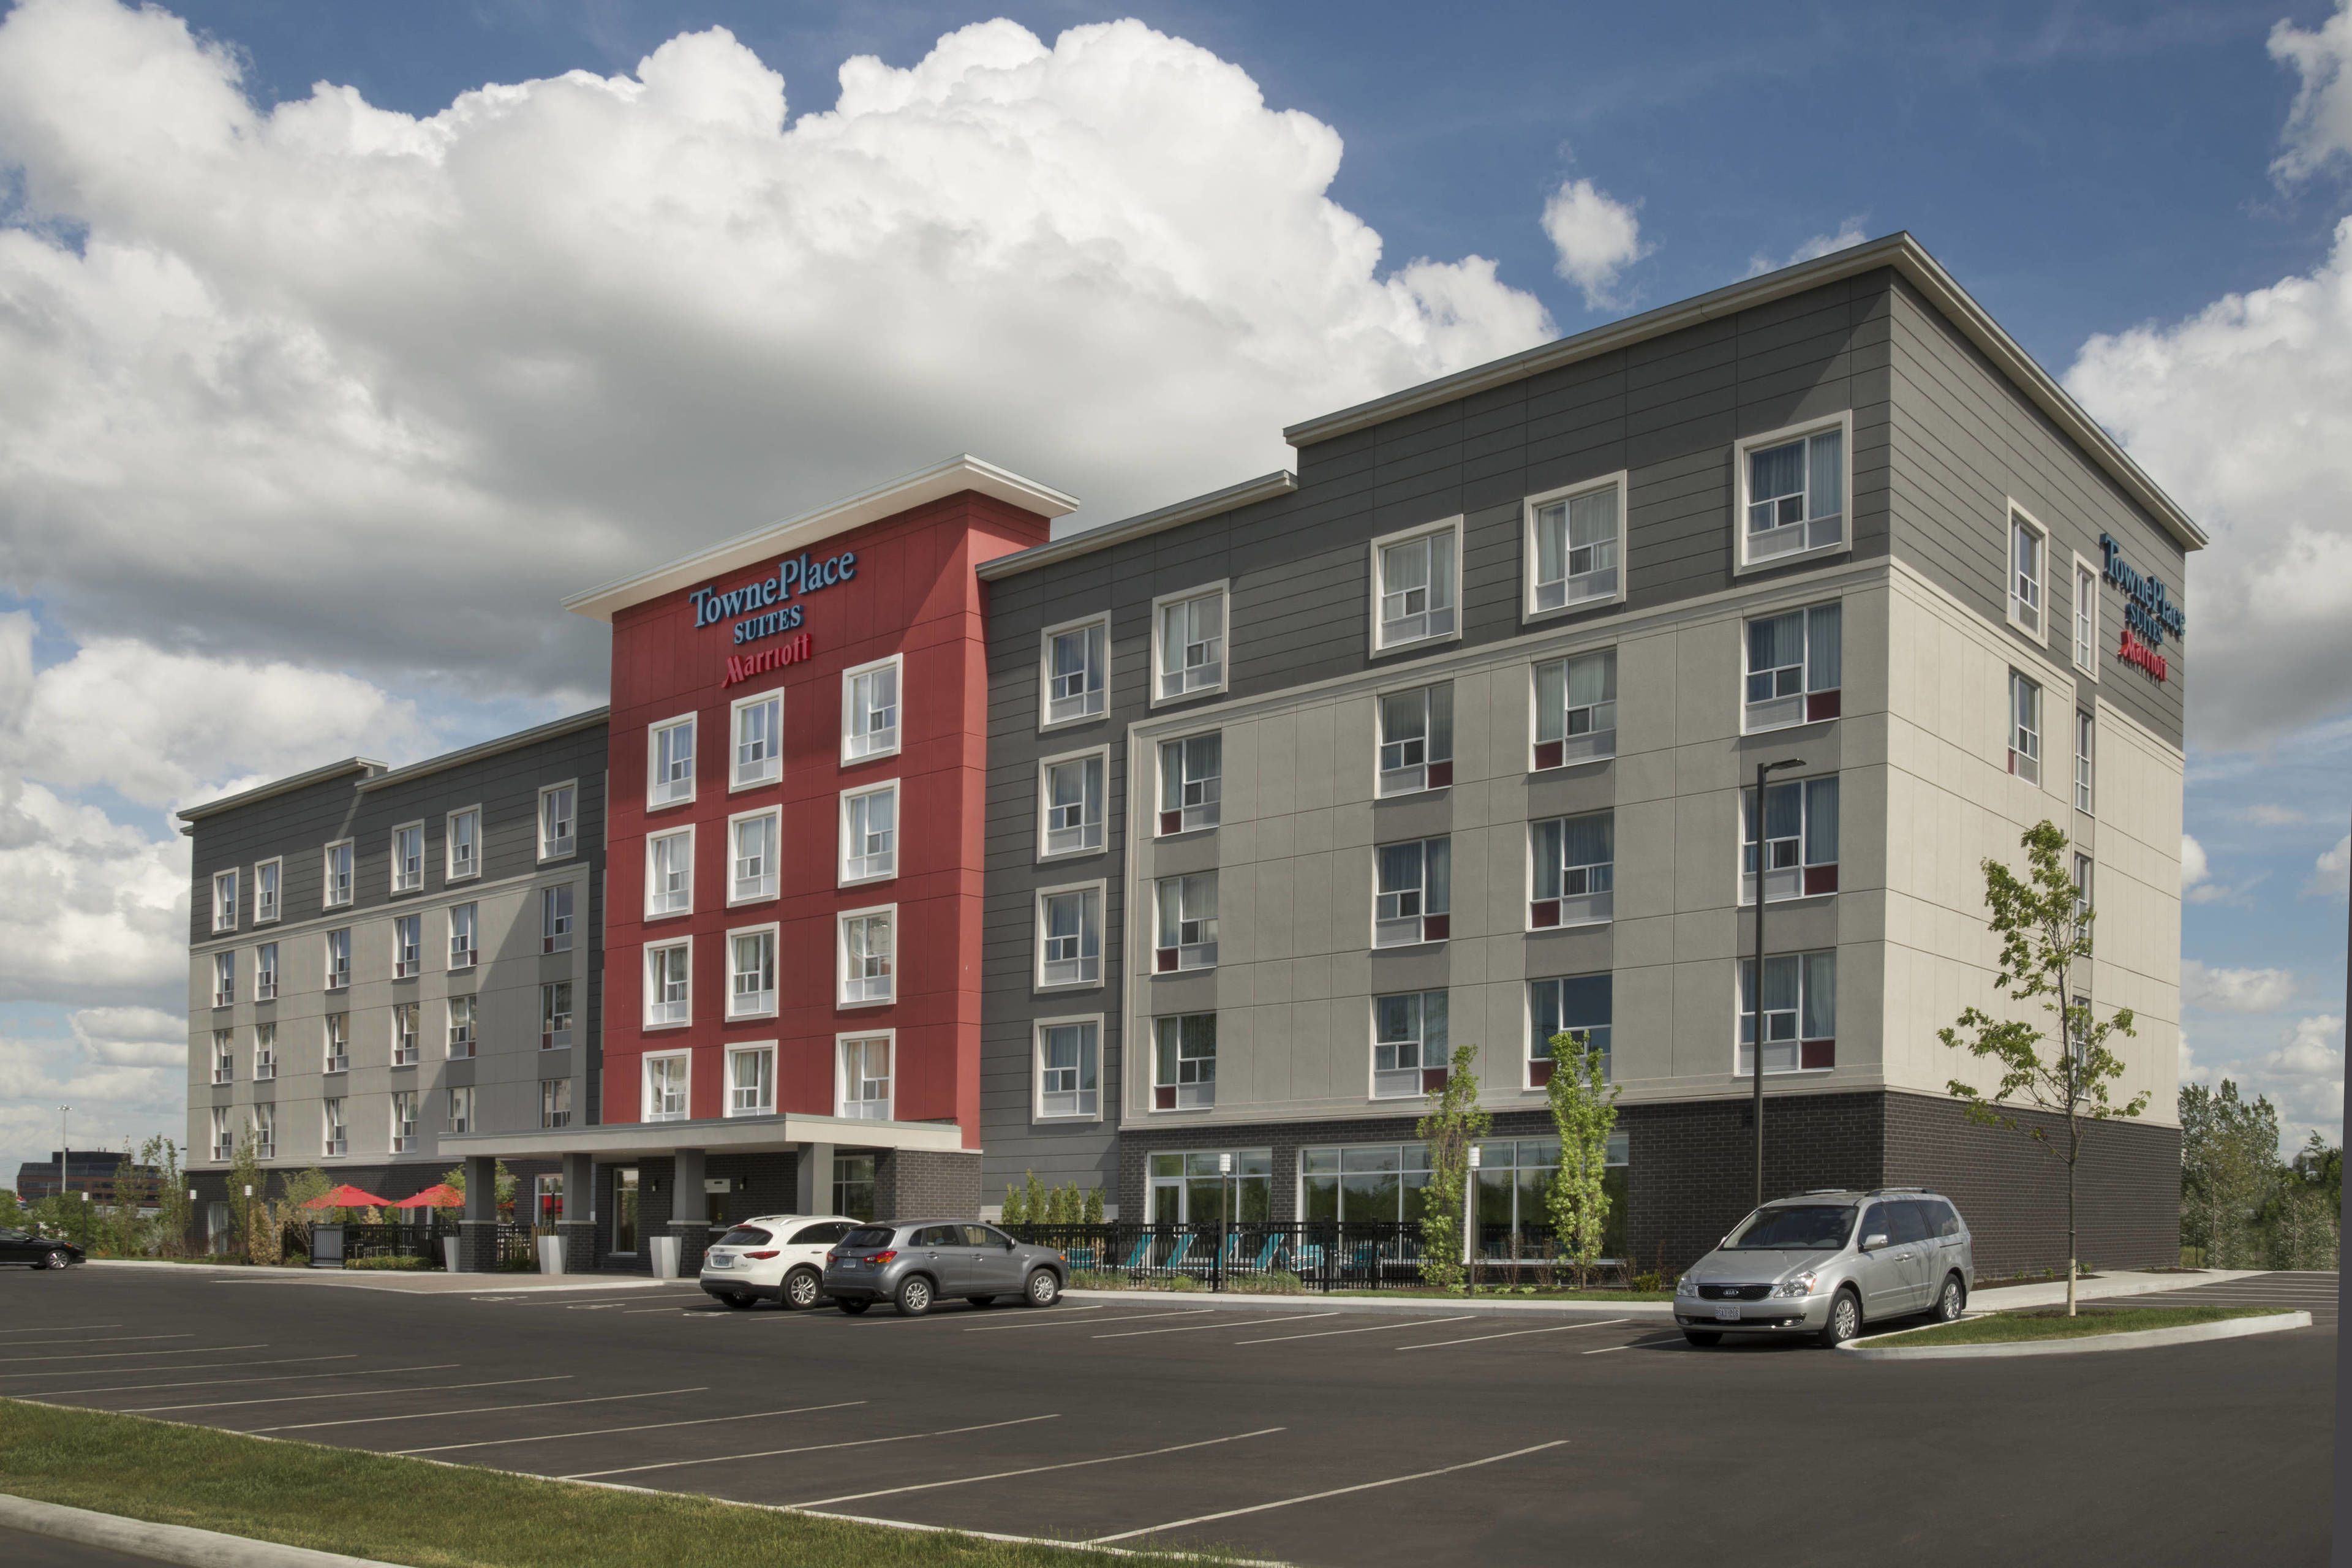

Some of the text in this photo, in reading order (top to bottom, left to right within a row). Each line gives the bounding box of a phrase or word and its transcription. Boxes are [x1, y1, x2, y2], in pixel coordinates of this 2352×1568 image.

[688, 552, 856, 628] TownePlace
[2100, 532, 2185, 636] TownePlace
[734, 604, 804, 644] SUITES
[2125, 603, 2163, 643] SUITES
[721, 633, 812, 688] Marriott
[2118, 629, 2166, 681] Marriott
